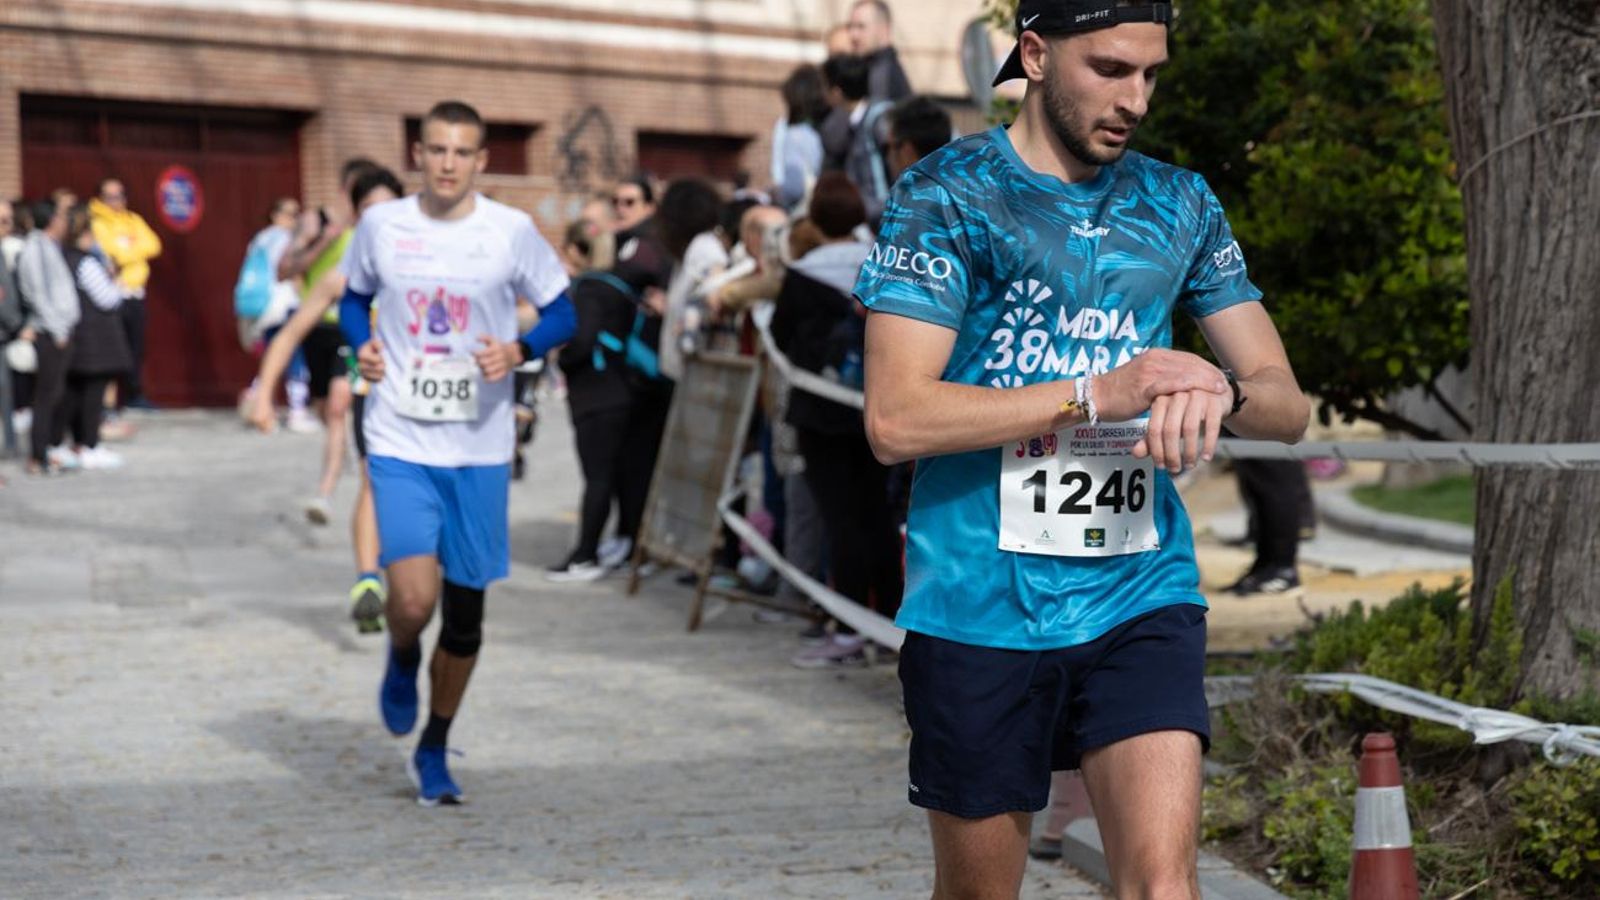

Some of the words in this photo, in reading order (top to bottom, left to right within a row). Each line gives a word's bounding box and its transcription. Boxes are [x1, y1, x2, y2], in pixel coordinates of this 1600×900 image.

[1075, 9, 1110, 23] DRI-FIT
[1055, 304, 1140, 341] MEDIA
[984, 327, 1049, 374] 38
[1041, 342, 1150, 376] MARA
[410, 377, 471, 401] 1038
[1021, 468, 1146, 515] 1246
